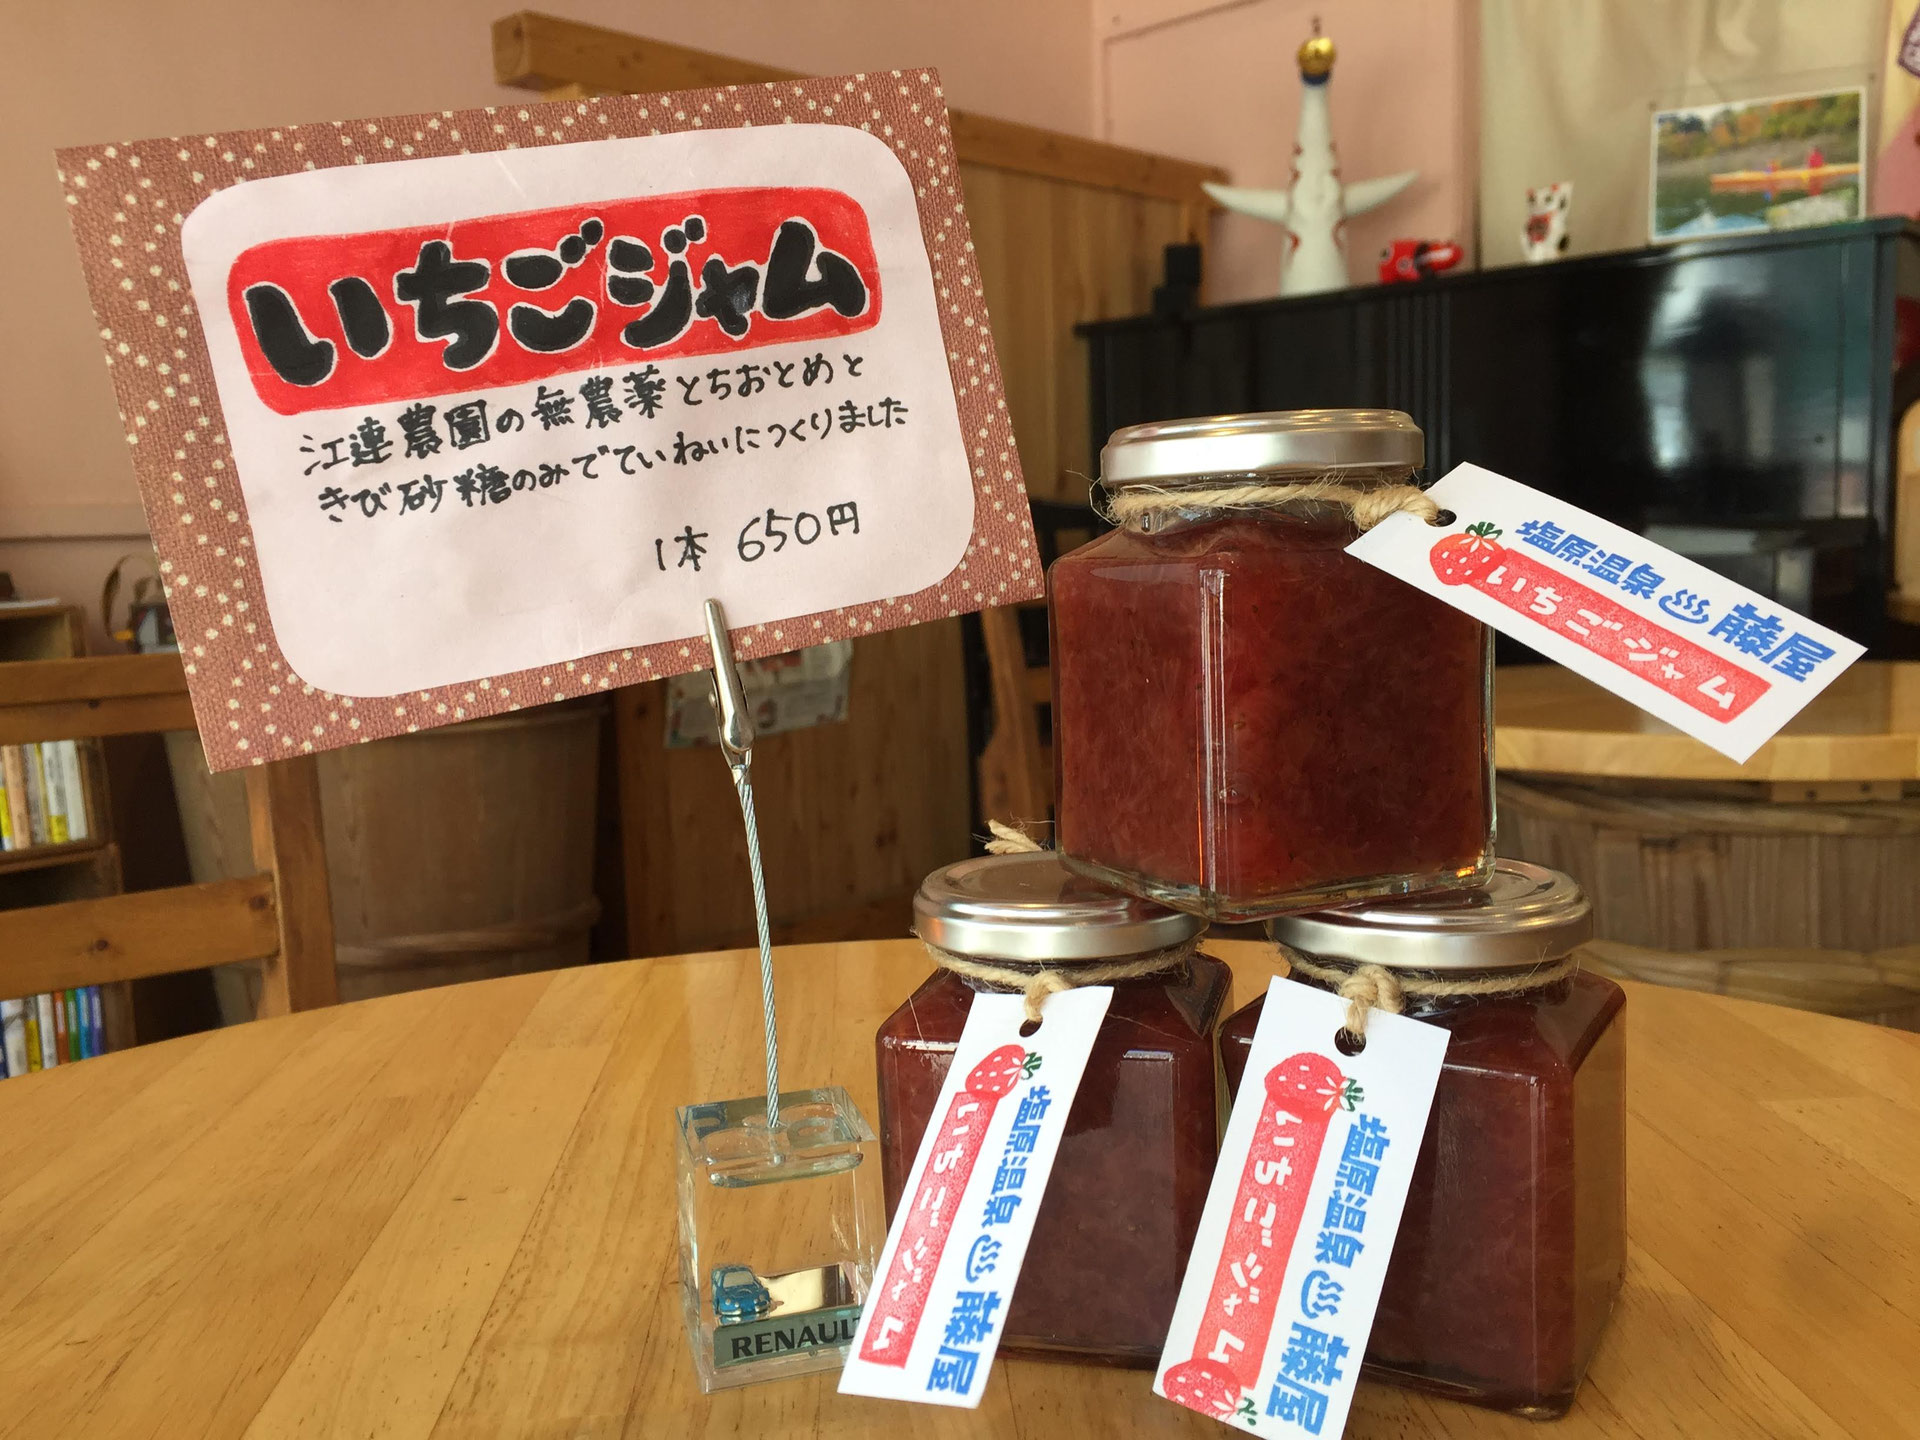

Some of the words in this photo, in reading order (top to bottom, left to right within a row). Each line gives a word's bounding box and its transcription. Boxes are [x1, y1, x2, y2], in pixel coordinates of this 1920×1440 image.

[245, 216, 869, 386] いちごジャム
[300, 353, 863, 475] 江連農園の無農薬とちおとめと
[318, 397, 908, 522] きび砂糖のみでていねいにつくりました
[655, 526, 708, 571] 1本
[738, 501, 860, 562] 650円
[1515, 520, 1666, 600] 塩原温泉
[1708, 602, 1837, 683] 藤屋
[1487, 565, 1737, 710] いちごジャム
[873, 1102, 980, 1351] いちごジャム
[981, 1085, 1052, 1227] 塩原温泉
[1315, 1113, 1391, 1269] 塩原温泉
[1208, 1109, 1303, 1363] いちごジャム
[926, 1290, 1002, 1396] 藤屋
[1266, 1321, 1350, 1436] 藤屋
